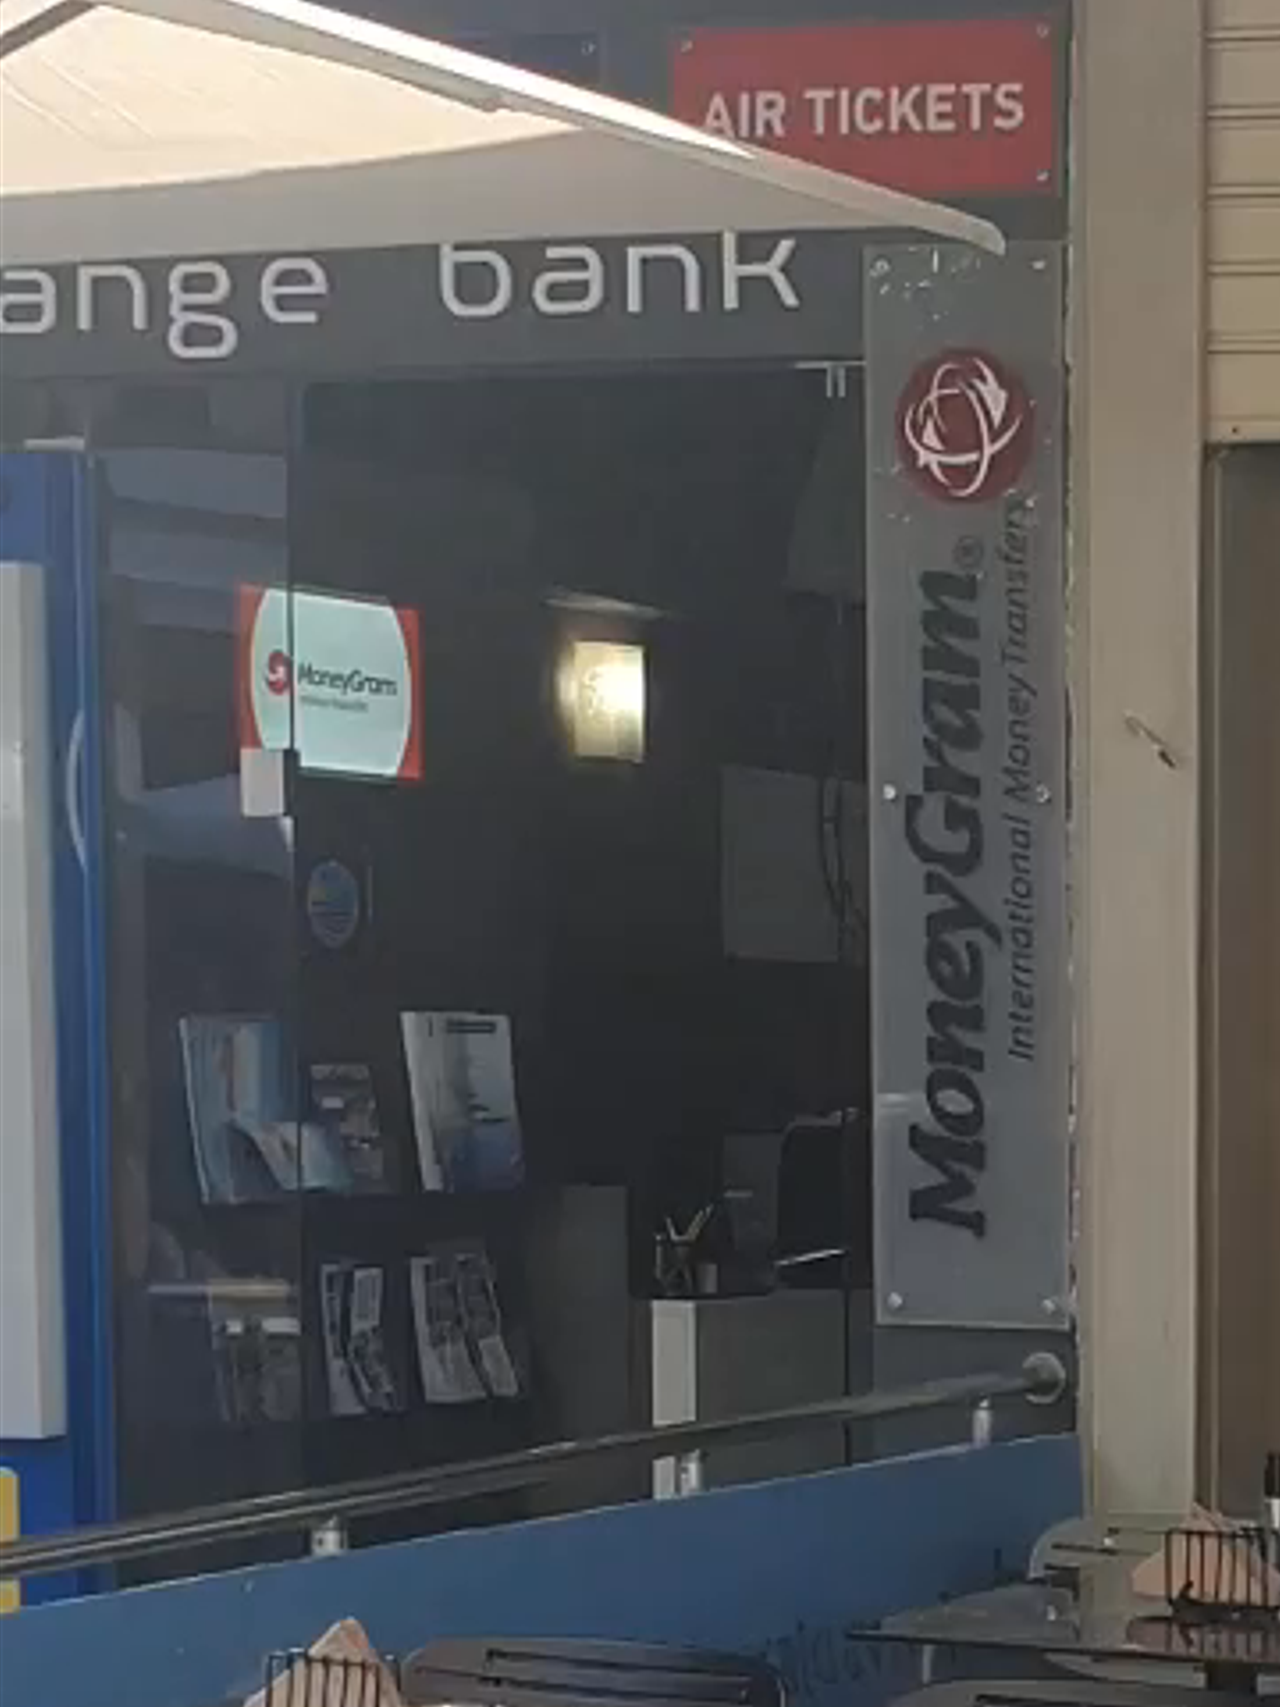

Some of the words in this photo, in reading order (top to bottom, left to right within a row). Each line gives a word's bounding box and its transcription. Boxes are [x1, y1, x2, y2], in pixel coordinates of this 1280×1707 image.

[702, 90, 787, 139] AIR
[803, 83, 1025, 136] TICKETS
[438, 230, 801, 317] bank
[297, 661, 398, 696] MoneyGram
[1001, 673, 1038, 804] Money
[1002, 812, 1036, 1062] International
